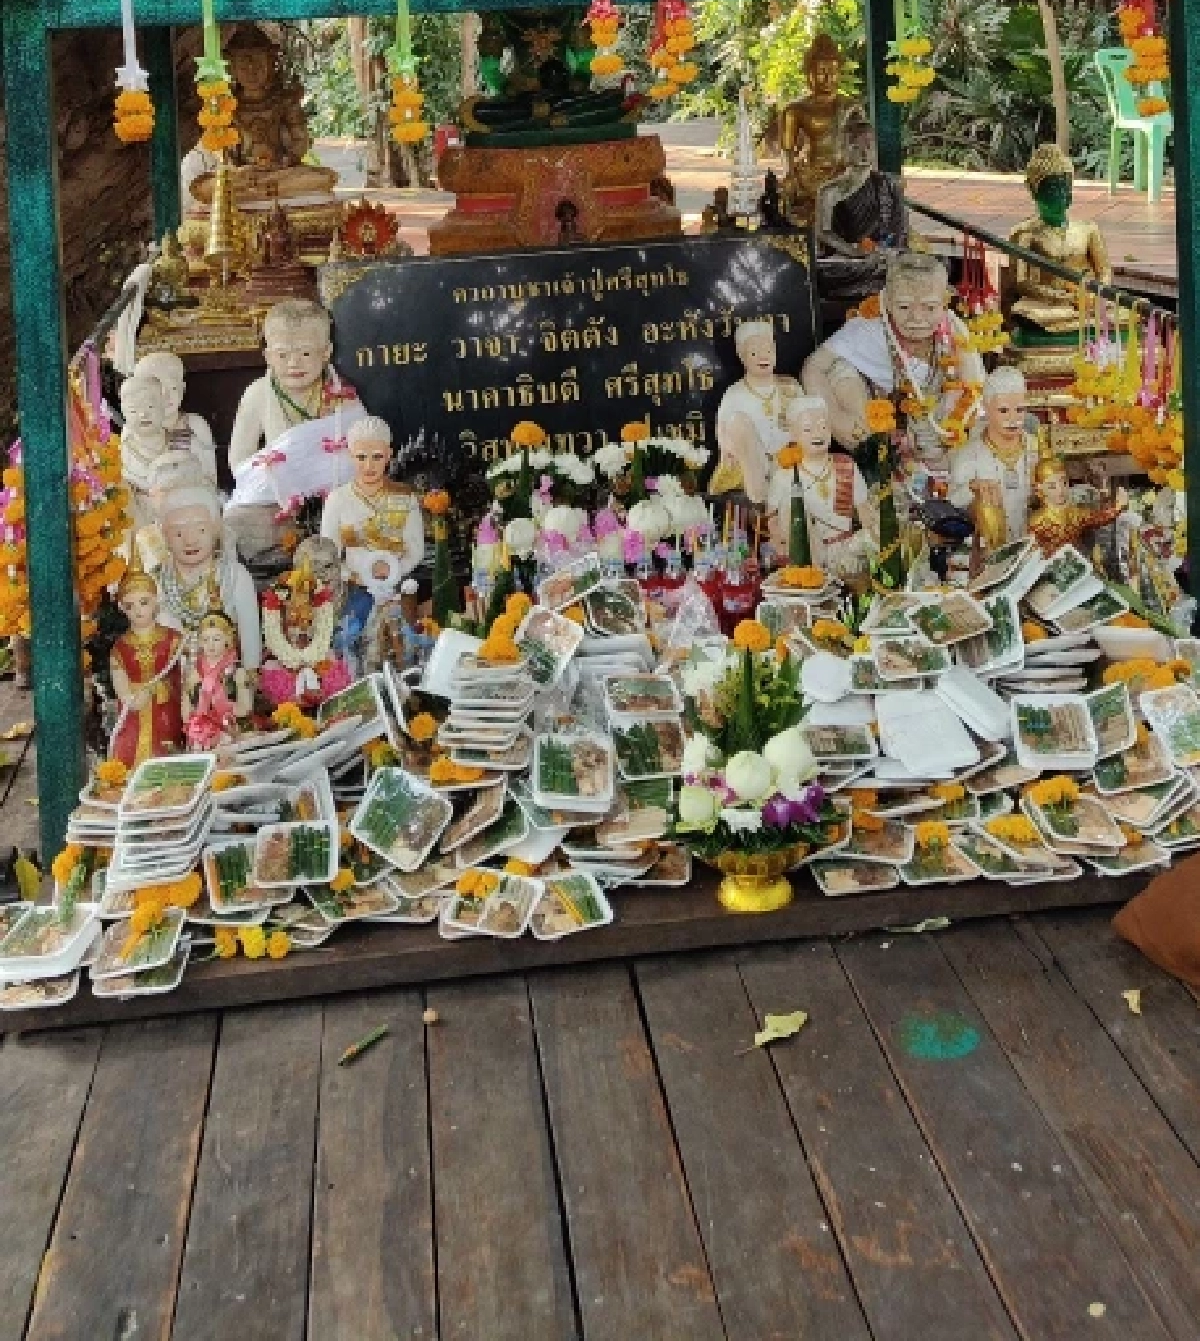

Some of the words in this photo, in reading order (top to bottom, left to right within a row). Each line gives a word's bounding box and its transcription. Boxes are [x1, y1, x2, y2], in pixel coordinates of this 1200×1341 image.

[356, 342, 428, 368] กายะ
[451, 334, 521, 359] วาจา
[539, 316, 619, 352] จิตตัง
[442, 365, 580, 412] นาคาธิบดี
[604, 360, 714, 407] ศรีสุทโธ
